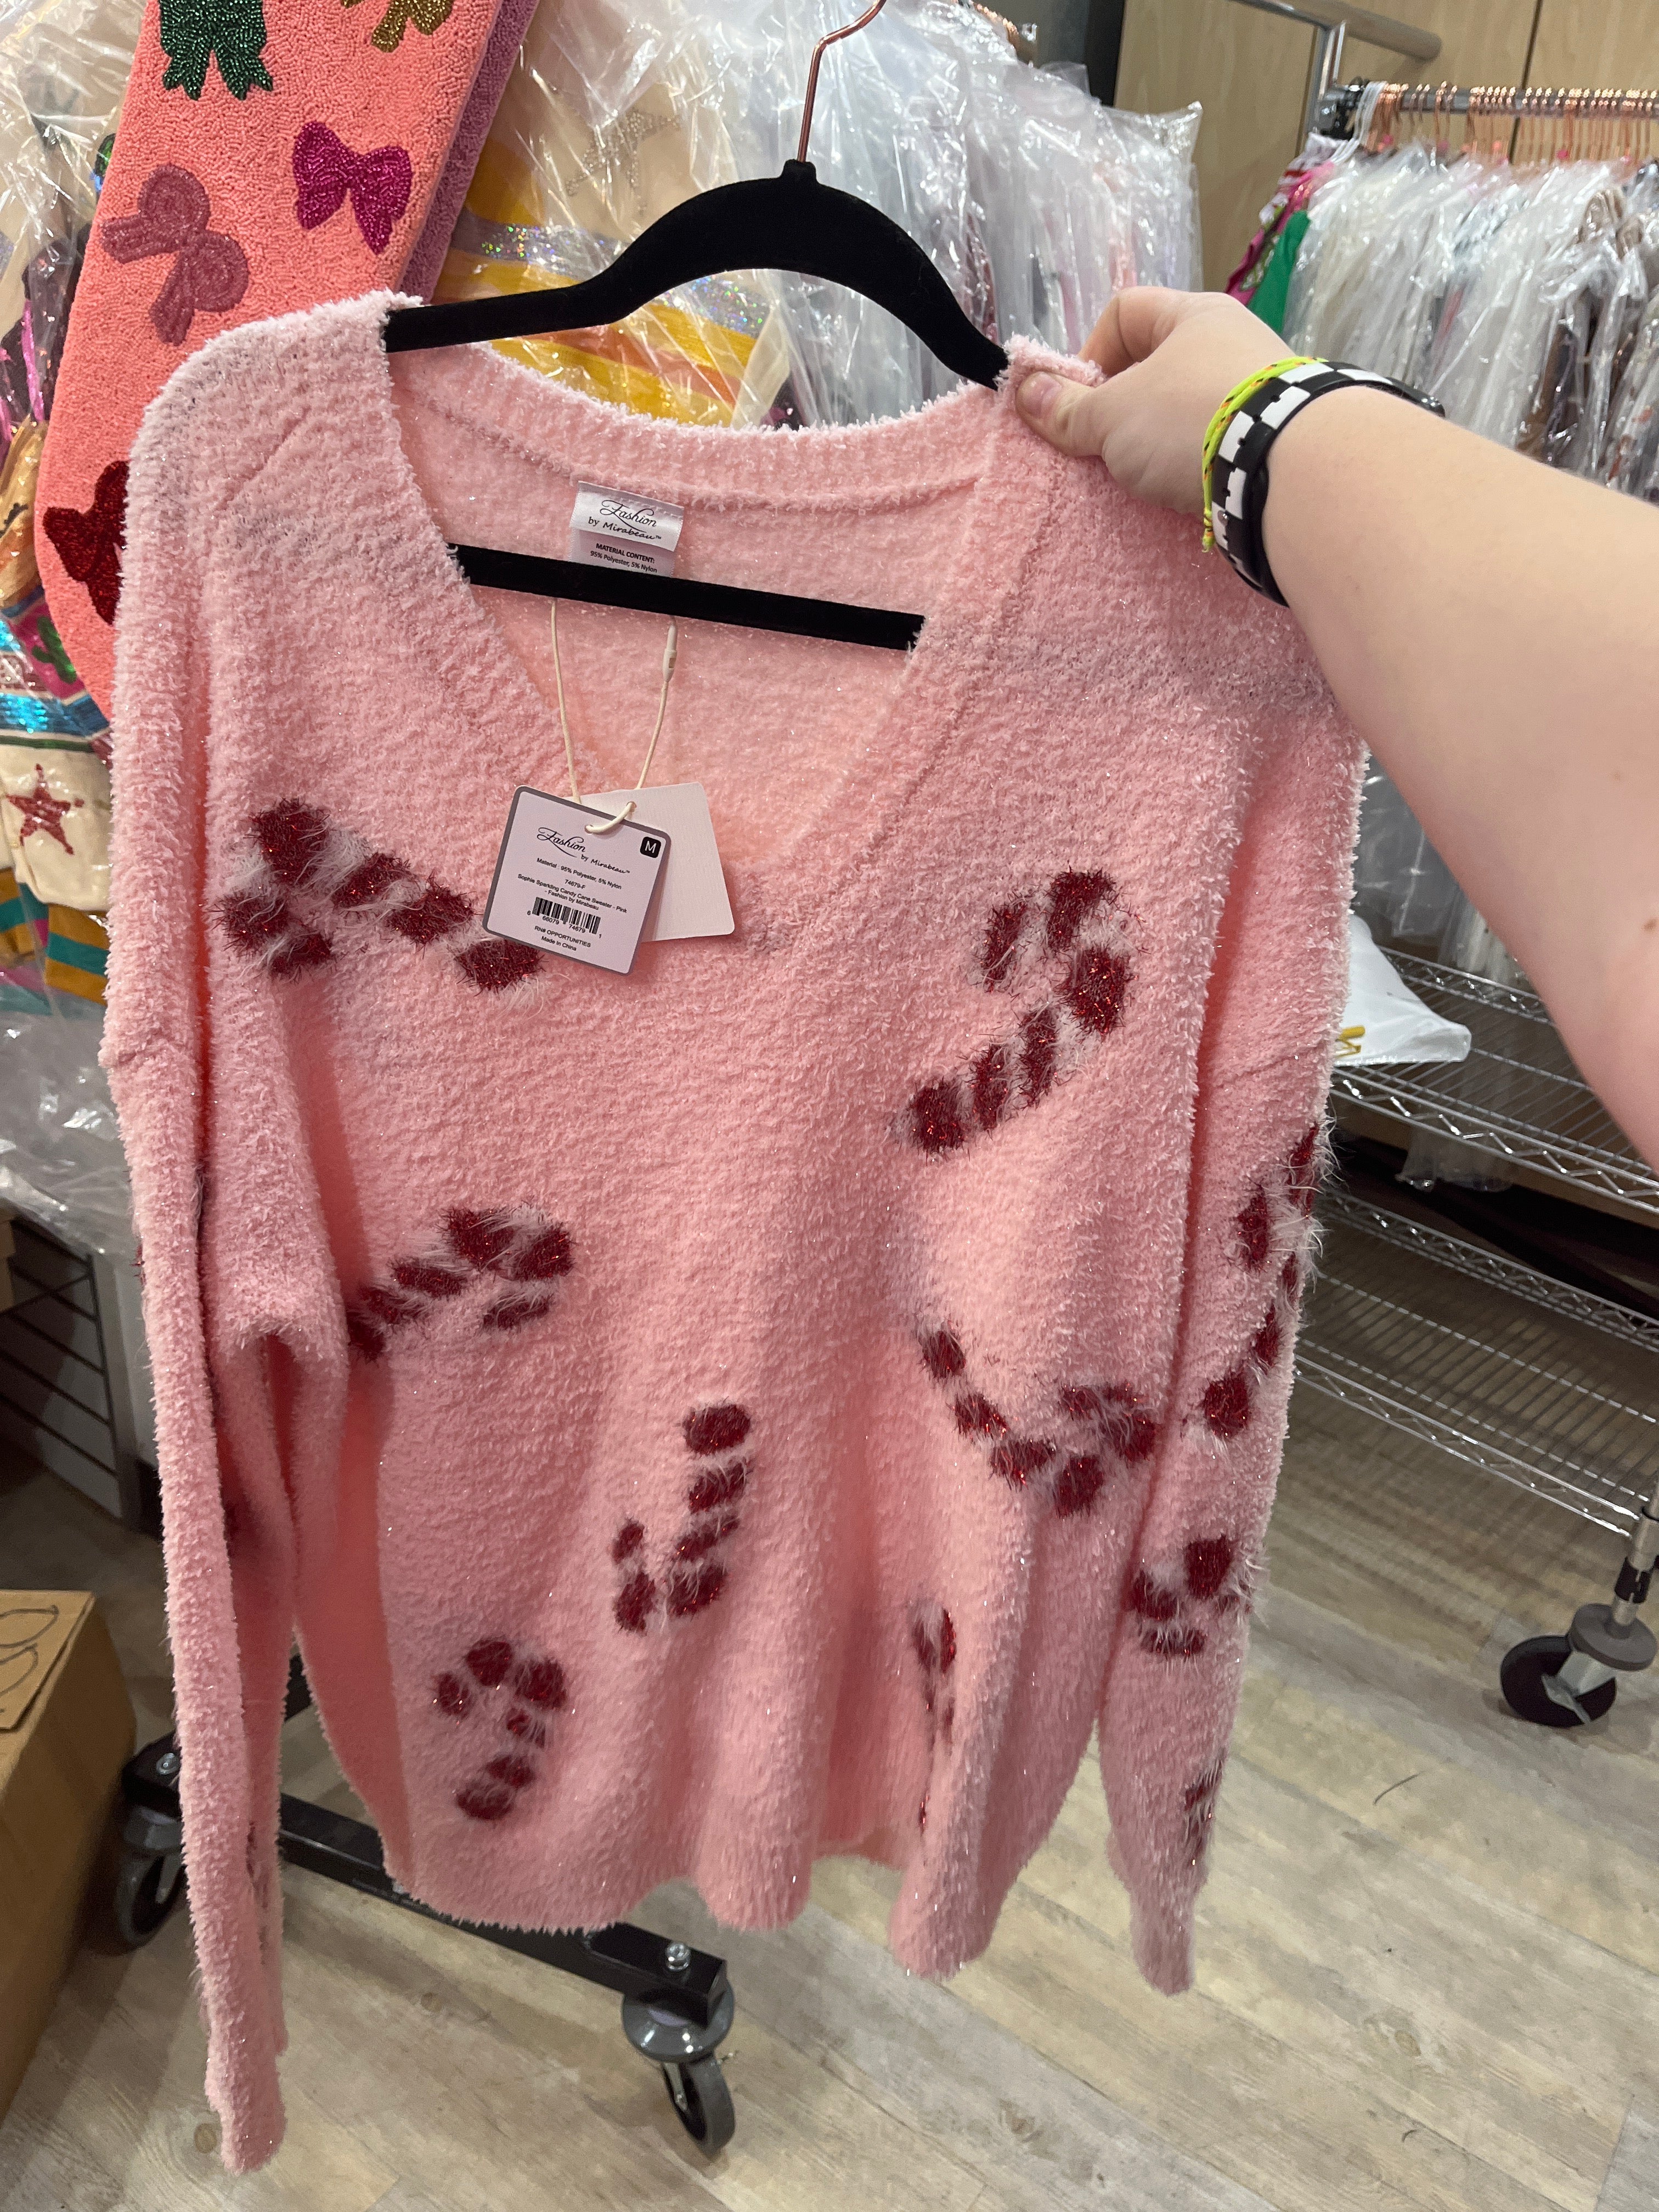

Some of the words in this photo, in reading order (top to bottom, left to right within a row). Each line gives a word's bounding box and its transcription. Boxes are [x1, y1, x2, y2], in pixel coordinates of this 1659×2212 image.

[588, 516, 600, 527] by
[600, 500, 657, 532] Fashion
[590, 550, 603, 559] 95%
[603, 554, 630, 567] Polyester,
[641, 564, 658, 573] Nylon
[596, 543, 625, 556] MATERIAL
[626, 551, 655, 564] CONTENT:
[537, 827, 586, 858] Fashion
[644, 840, 657, 854] M
[536, 857, 557, 868] Material
[573, 870, 597, 882] Polyester,
[607, 881, 622, 889] Nylon
[536, 879, 560, 892] Sparkling
[560, 888, 577, 898] Candy
[591, 898, 612, 909] Sweater
[565, 879, 586, 889] 74679-F
[548, 890, 568, 900] Fashion
[575, 899, 599, 911] Mirabeau
[542, 916, 560, 925] 66079
[568, 924, 586, 934] 74679
[541, 935, 556, 945] Made
[562, 942, 577, 951] China
[546, 929, 591, 948] OPPORTUNITIES
